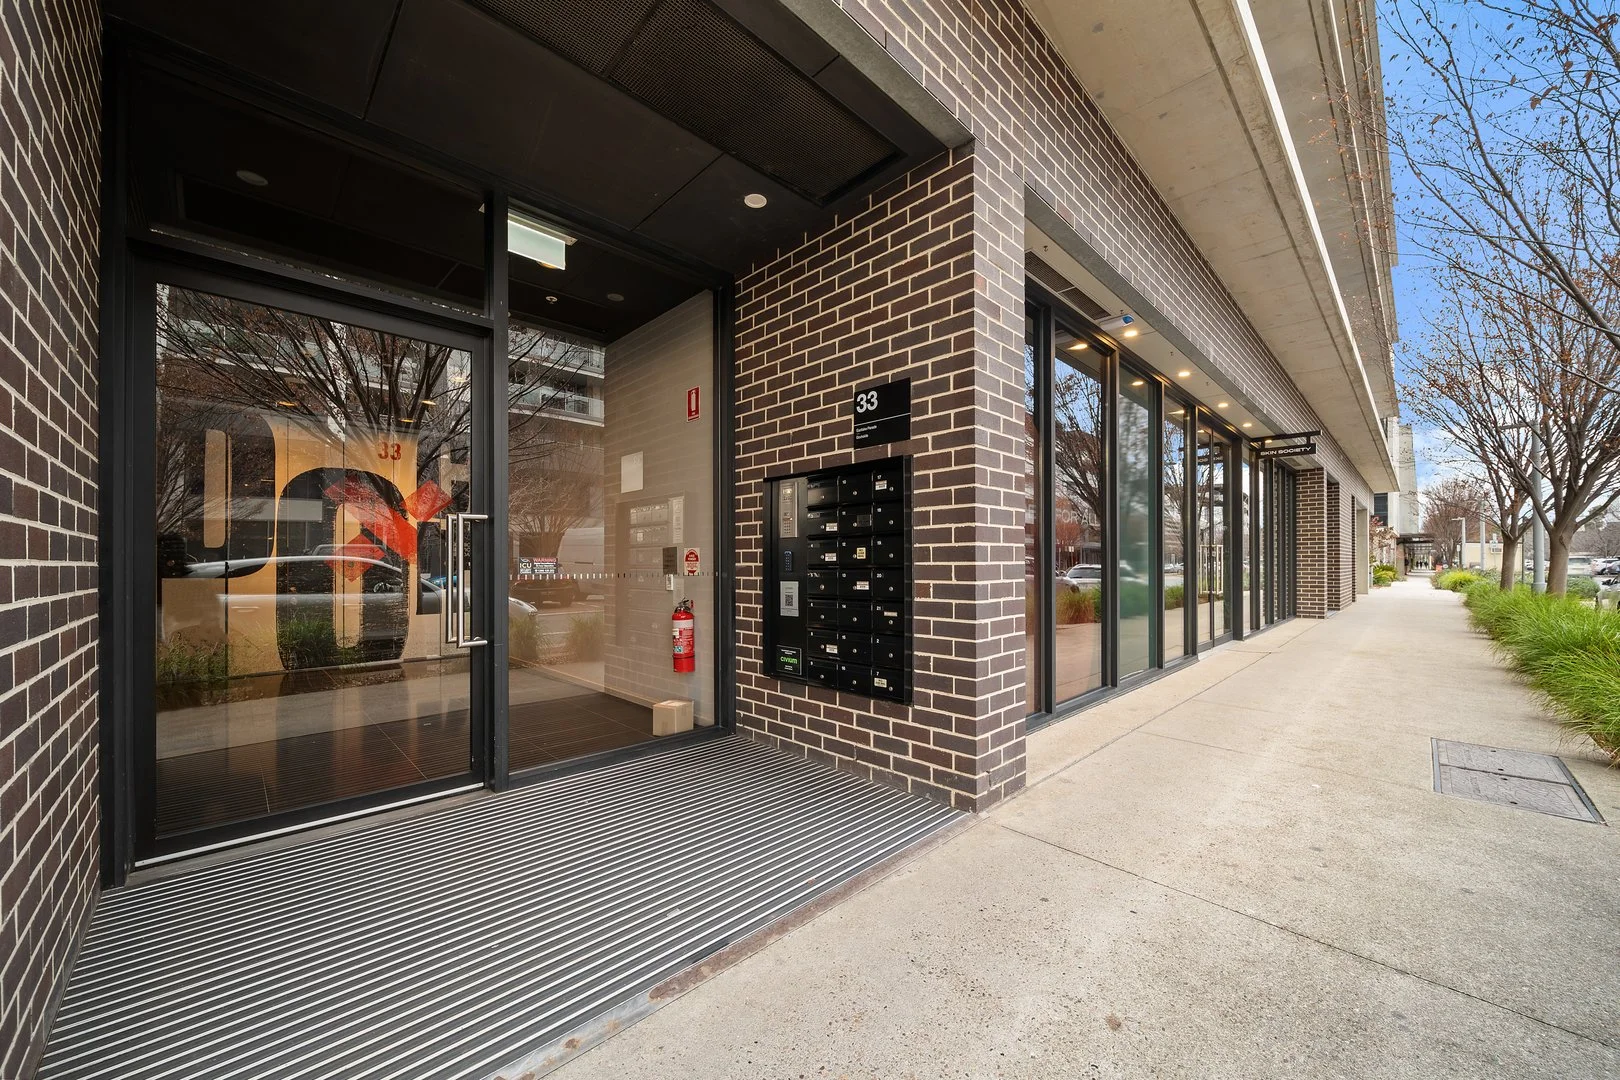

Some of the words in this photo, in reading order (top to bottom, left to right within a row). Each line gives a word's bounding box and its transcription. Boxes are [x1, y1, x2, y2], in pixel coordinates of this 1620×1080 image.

[856, 390, 878, 413] 33
[378, 441, 402, 460] 33
[1278, 446, 1311, 454] SOCIETY
